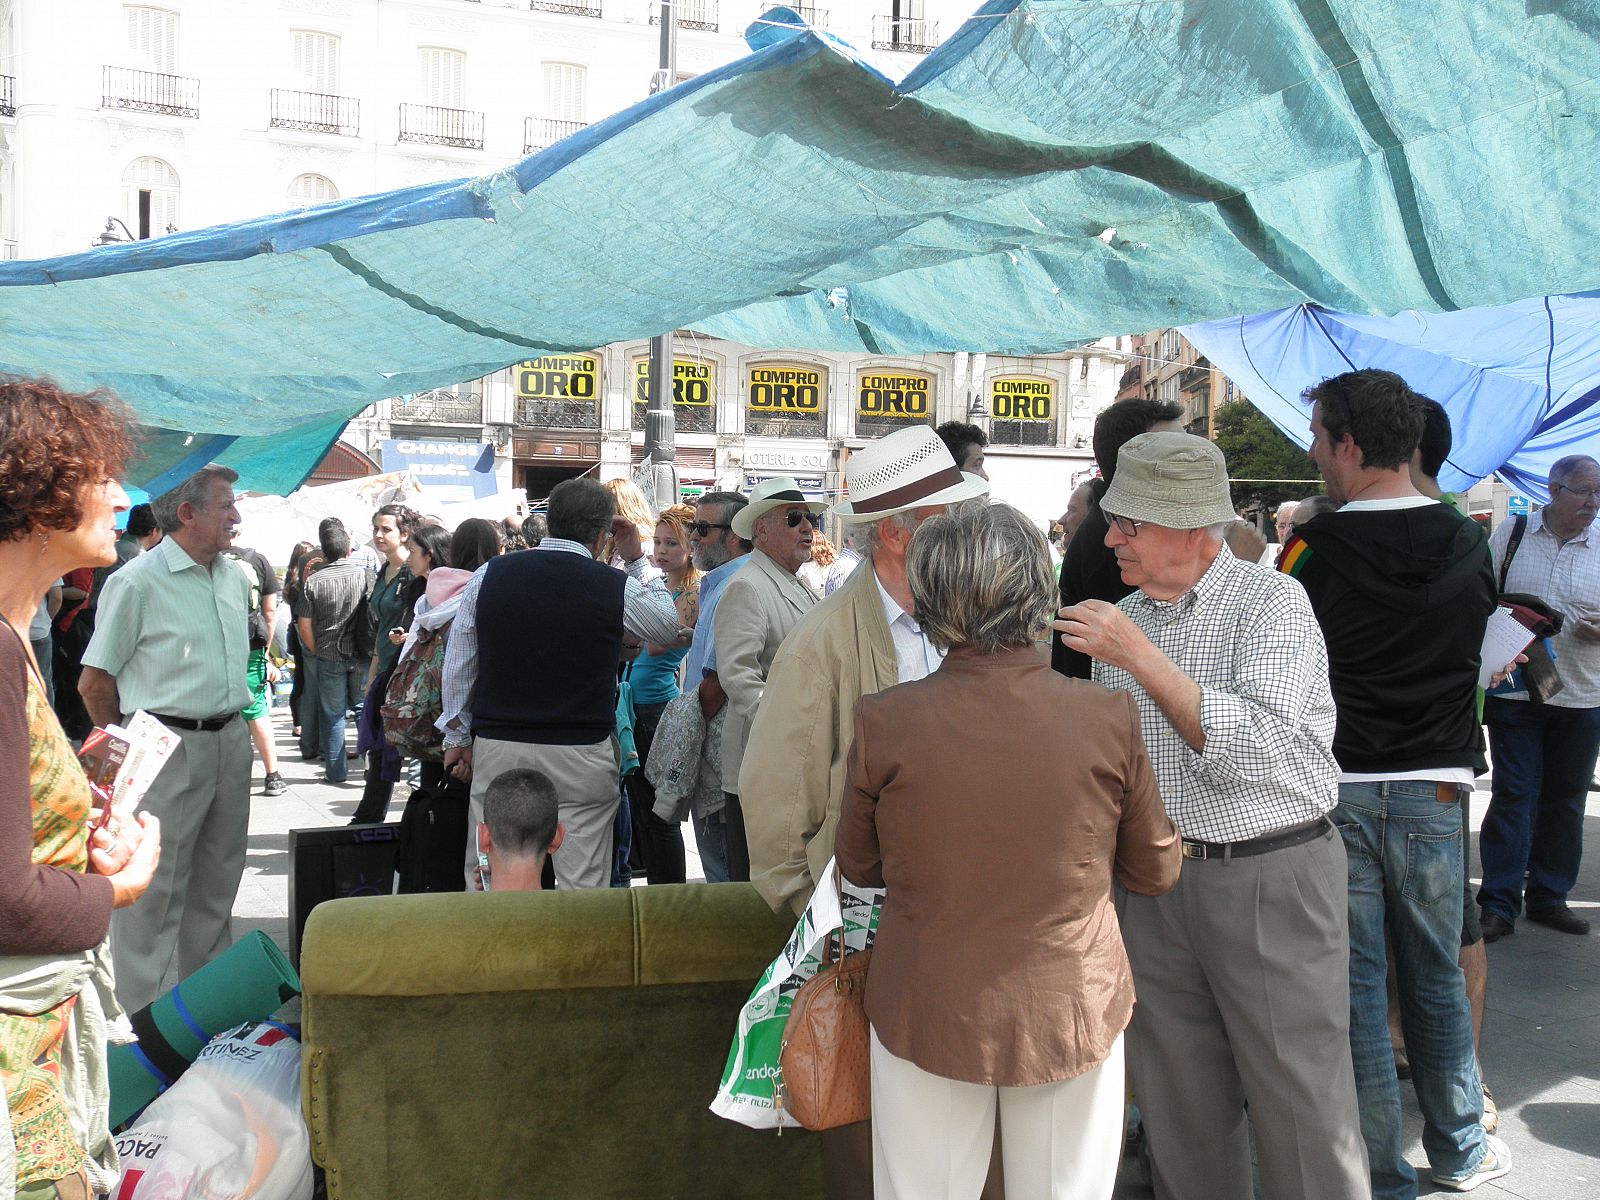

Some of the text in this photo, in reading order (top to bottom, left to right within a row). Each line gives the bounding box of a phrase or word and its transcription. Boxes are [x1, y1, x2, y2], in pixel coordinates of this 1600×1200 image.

[520, 358, 594, 371] COMPRO
[637, 363, 709, 379] CPRO
[520, 371, 594, 397] ORO
[751, 369, 819, 385] COMPRO
[861, 376, 928, 391] COMPRO
[750, 383, 819, 409] ORO
[993, 381, 1050, 395] COMPRO
[860, 388, 927, 414] ORO
[993, 394, 1051, 419] ORO
[396, 441, 479, 456] CHANGE
[801, 455, 827, 468] SOL
